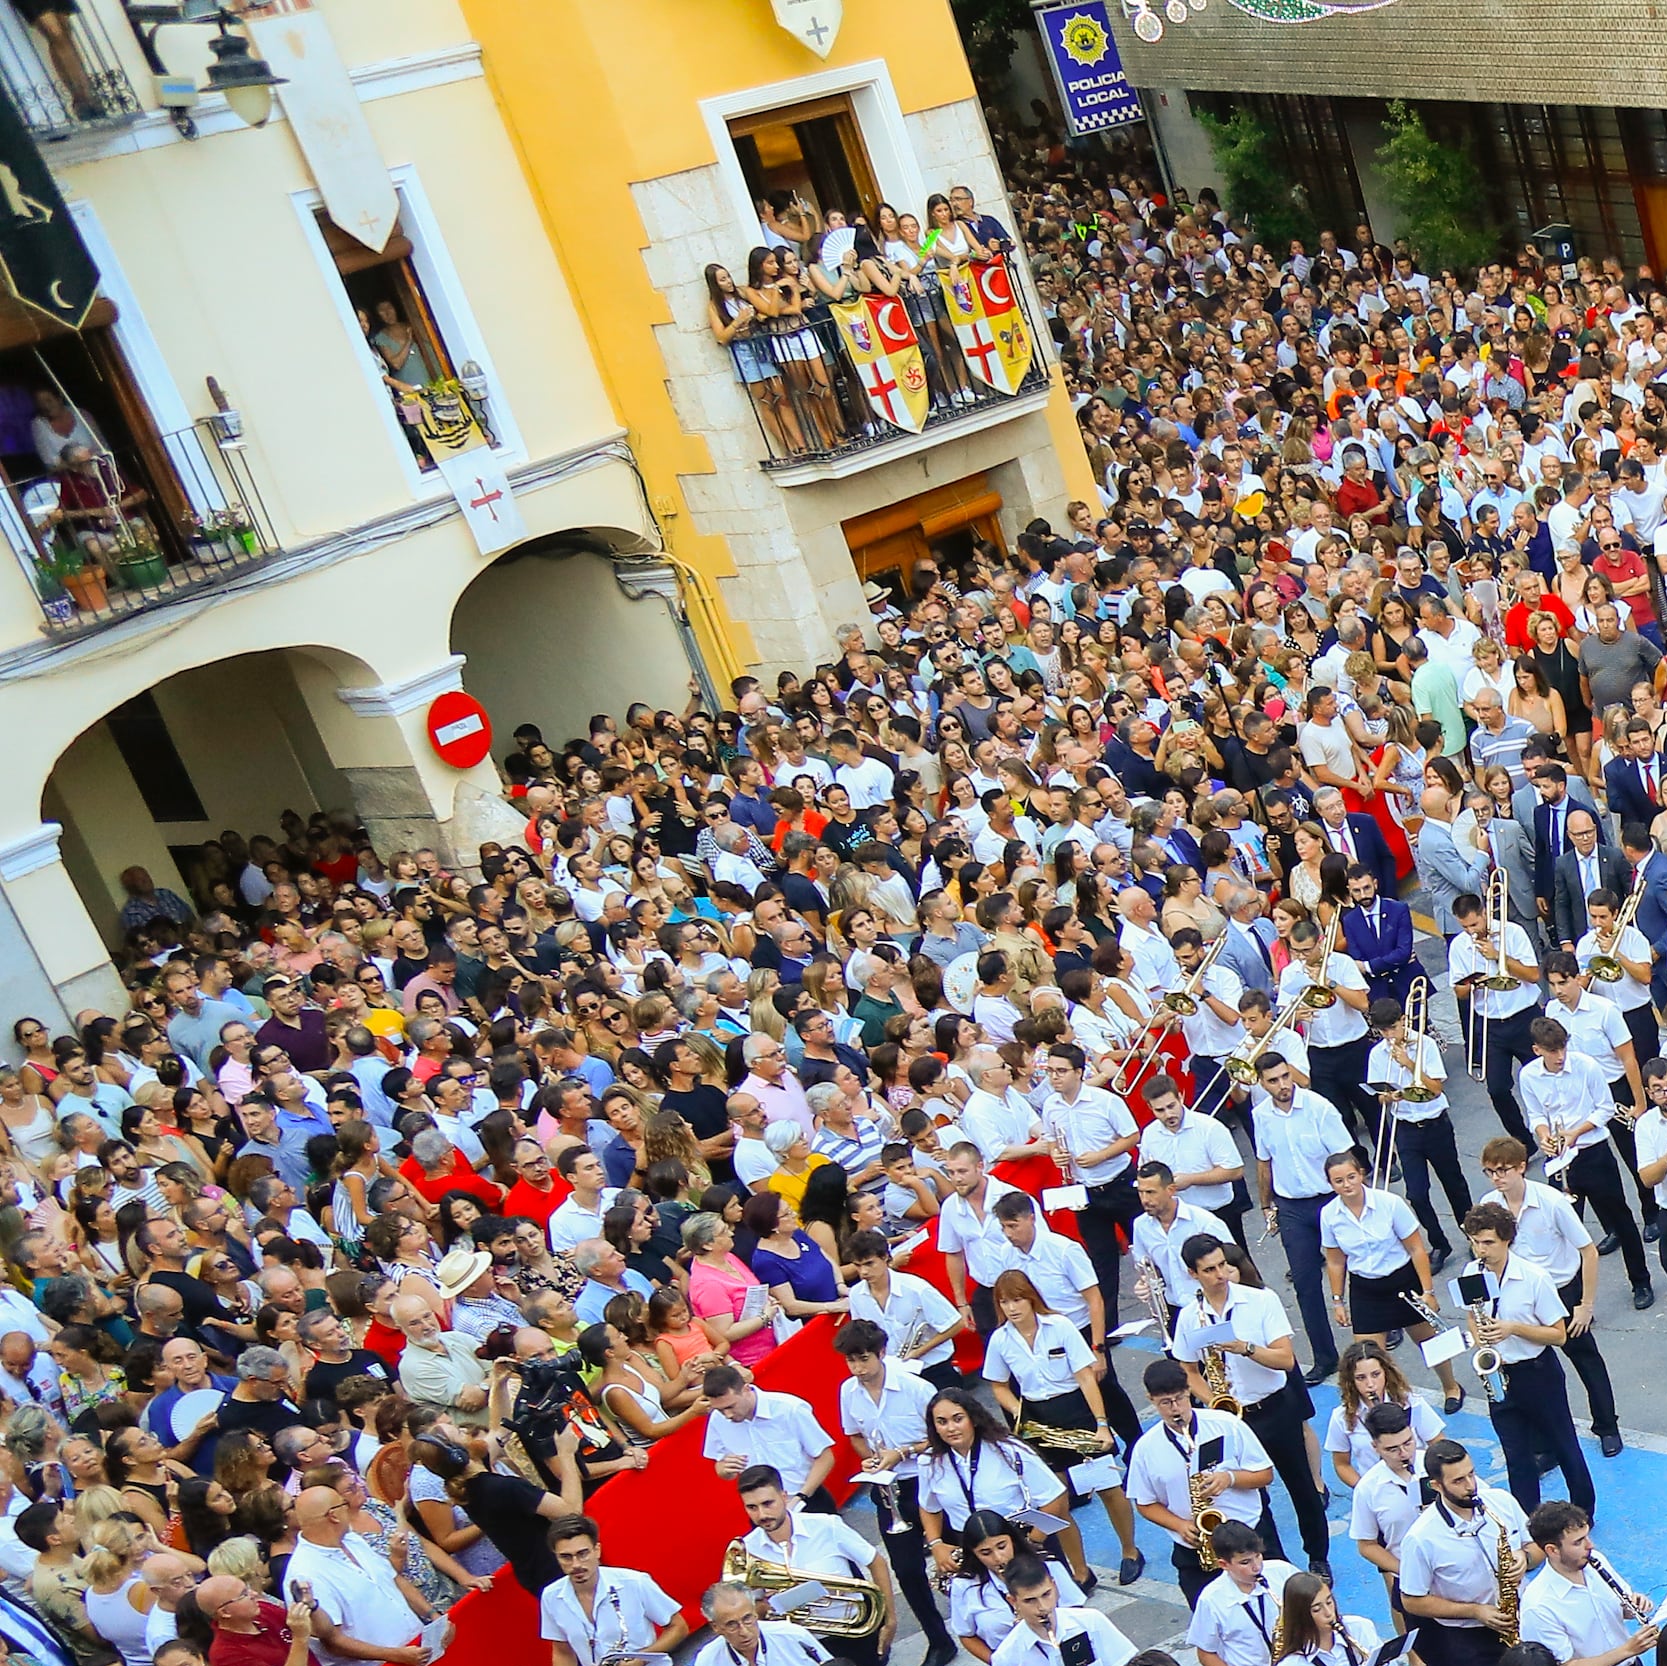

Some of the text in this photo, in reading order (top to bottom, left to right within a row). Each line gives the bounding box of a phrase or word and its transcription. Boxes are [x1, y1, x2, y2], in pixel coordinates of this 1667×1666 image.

[1068, 71, 1126, 93] POLICIA
[1077, 87, 1129, 108] LOCAL
[1561, 243, 1570, 258] P
